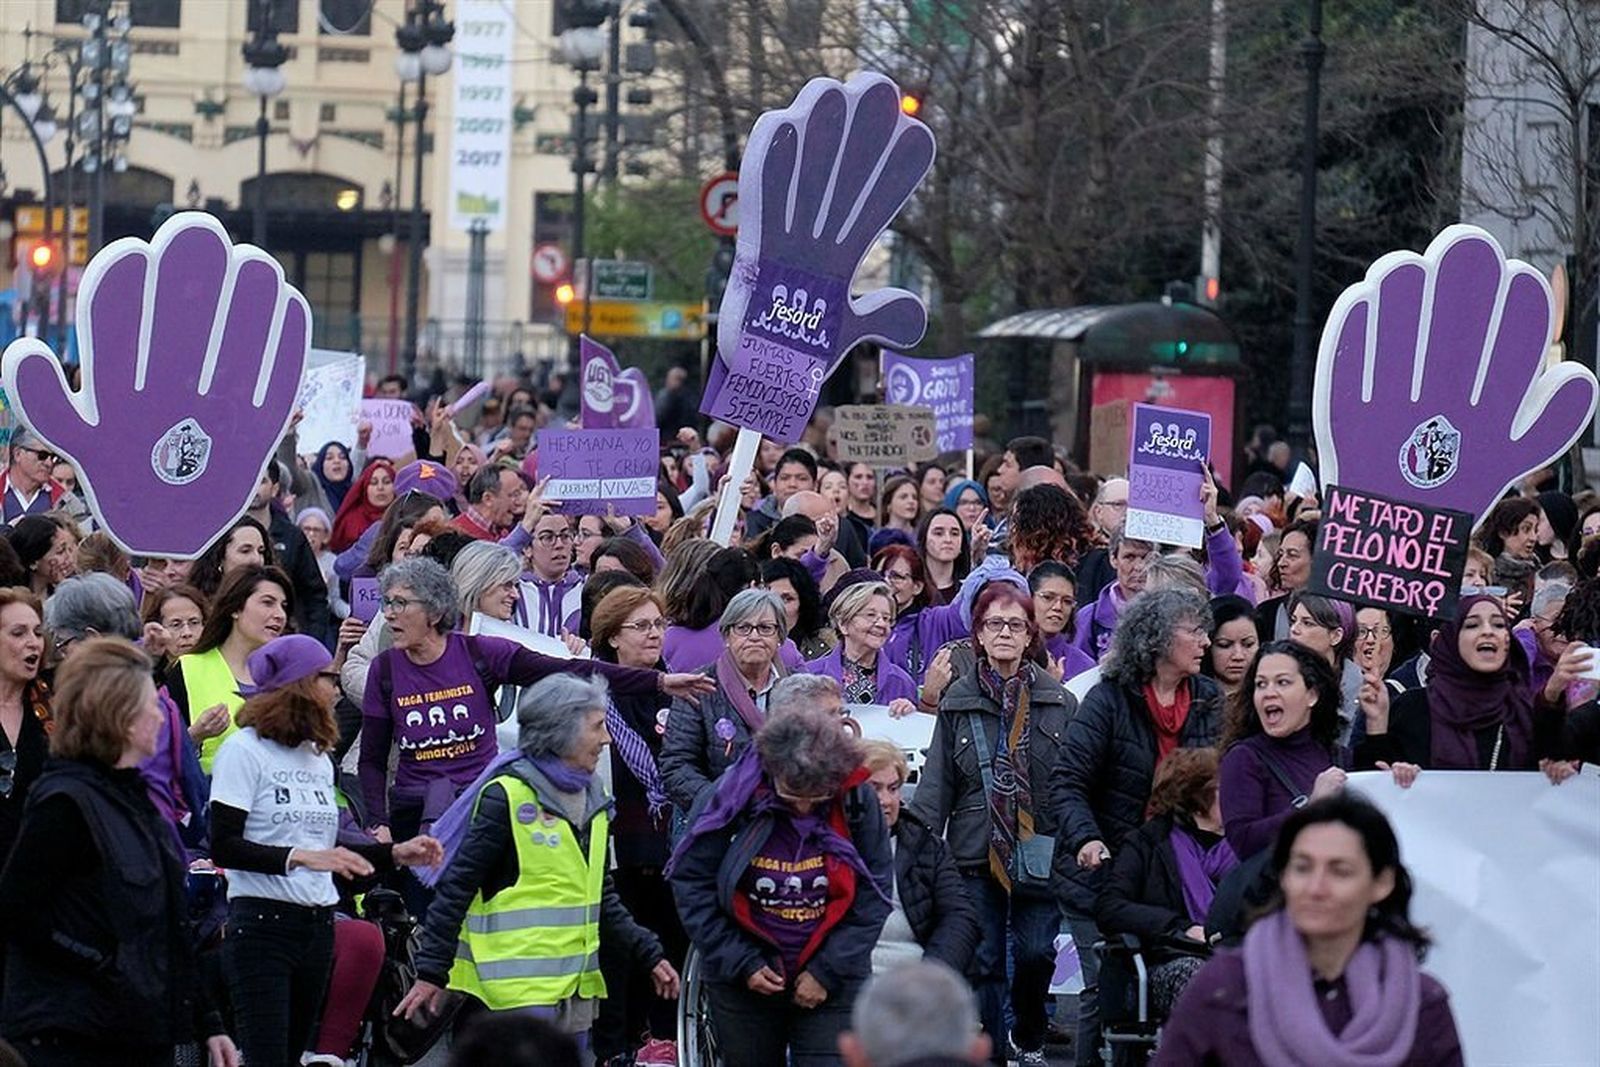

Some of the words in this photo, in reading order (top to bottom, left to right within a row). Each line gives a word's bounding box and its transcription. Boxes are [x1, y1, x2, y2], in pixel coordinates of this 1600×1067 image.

[457, 117, 503, 133] 2007
[457, 150, 502, 166] 2017
[767, 299, 822, 330] fesord
[742, 337, 794, 365] JUNTAS
[806, 358, 817, 371] Y
[588, 363, 612, 387] UGT
[750, 358, 807, 392] FUERTES
[727, 373, 811, 417] FEMINISTAS
[923, 378, 959, 400] GRITO
[725, 396, 793, 436] SIEMPRE
[634, 437, 652, 453] YO
[1149, 431, 1193, 449] fesord
[585, 459, 604, 477] TE
[603, 479, 652, 495] VIVAS
[1329, 490, 1365, 525] ME
[1369, 499, 1424, 536] TAPO
[1429, 514, 1459, 544] EL
[1323, 522, 1384, 562] PELO
[1386, 534, 1422, 570] NO
[1422, 542, 1452, 578] EL
[397, 694, 423, 707] VAGA
[425, 685, 475, 703] FEMINISTA
[271, 810, 303, 825] CASI
